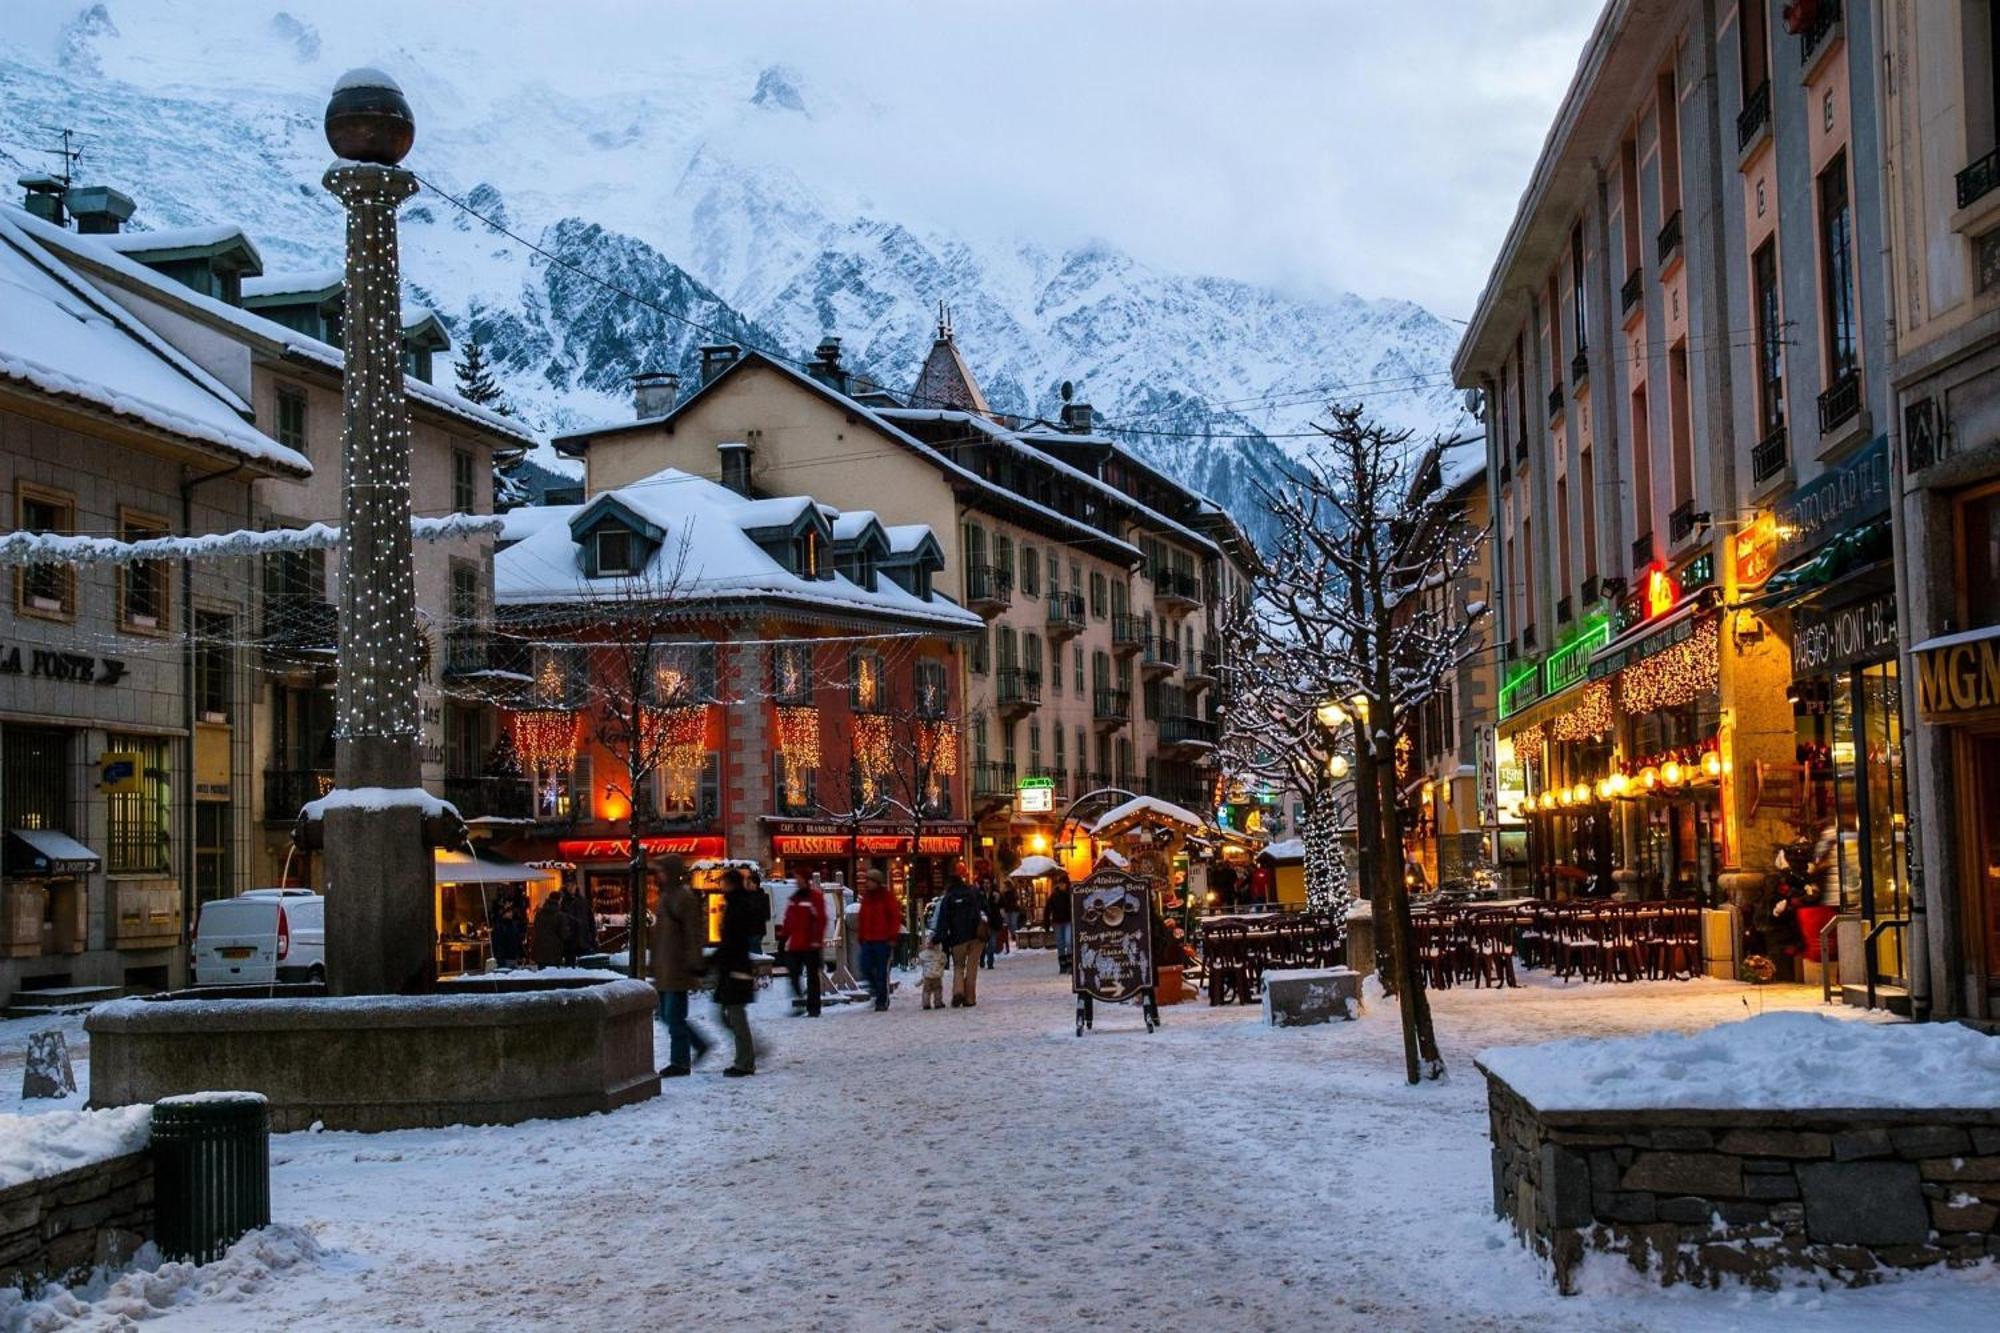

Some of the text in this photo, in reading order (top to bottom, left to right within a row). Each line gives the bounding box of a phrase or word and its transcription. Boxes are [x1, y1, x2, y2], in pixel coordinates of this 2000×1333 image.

[1834, 607, 1866, 659] MONT
[32, 649, 95, 686] POSTE
[1483, 728, 1495, 822] CINEMA
[583, 842, 600, 856] le
[782, 838, 845, 855] BRASSERIE
[906, 838, 961, 855] RSTAURANT
